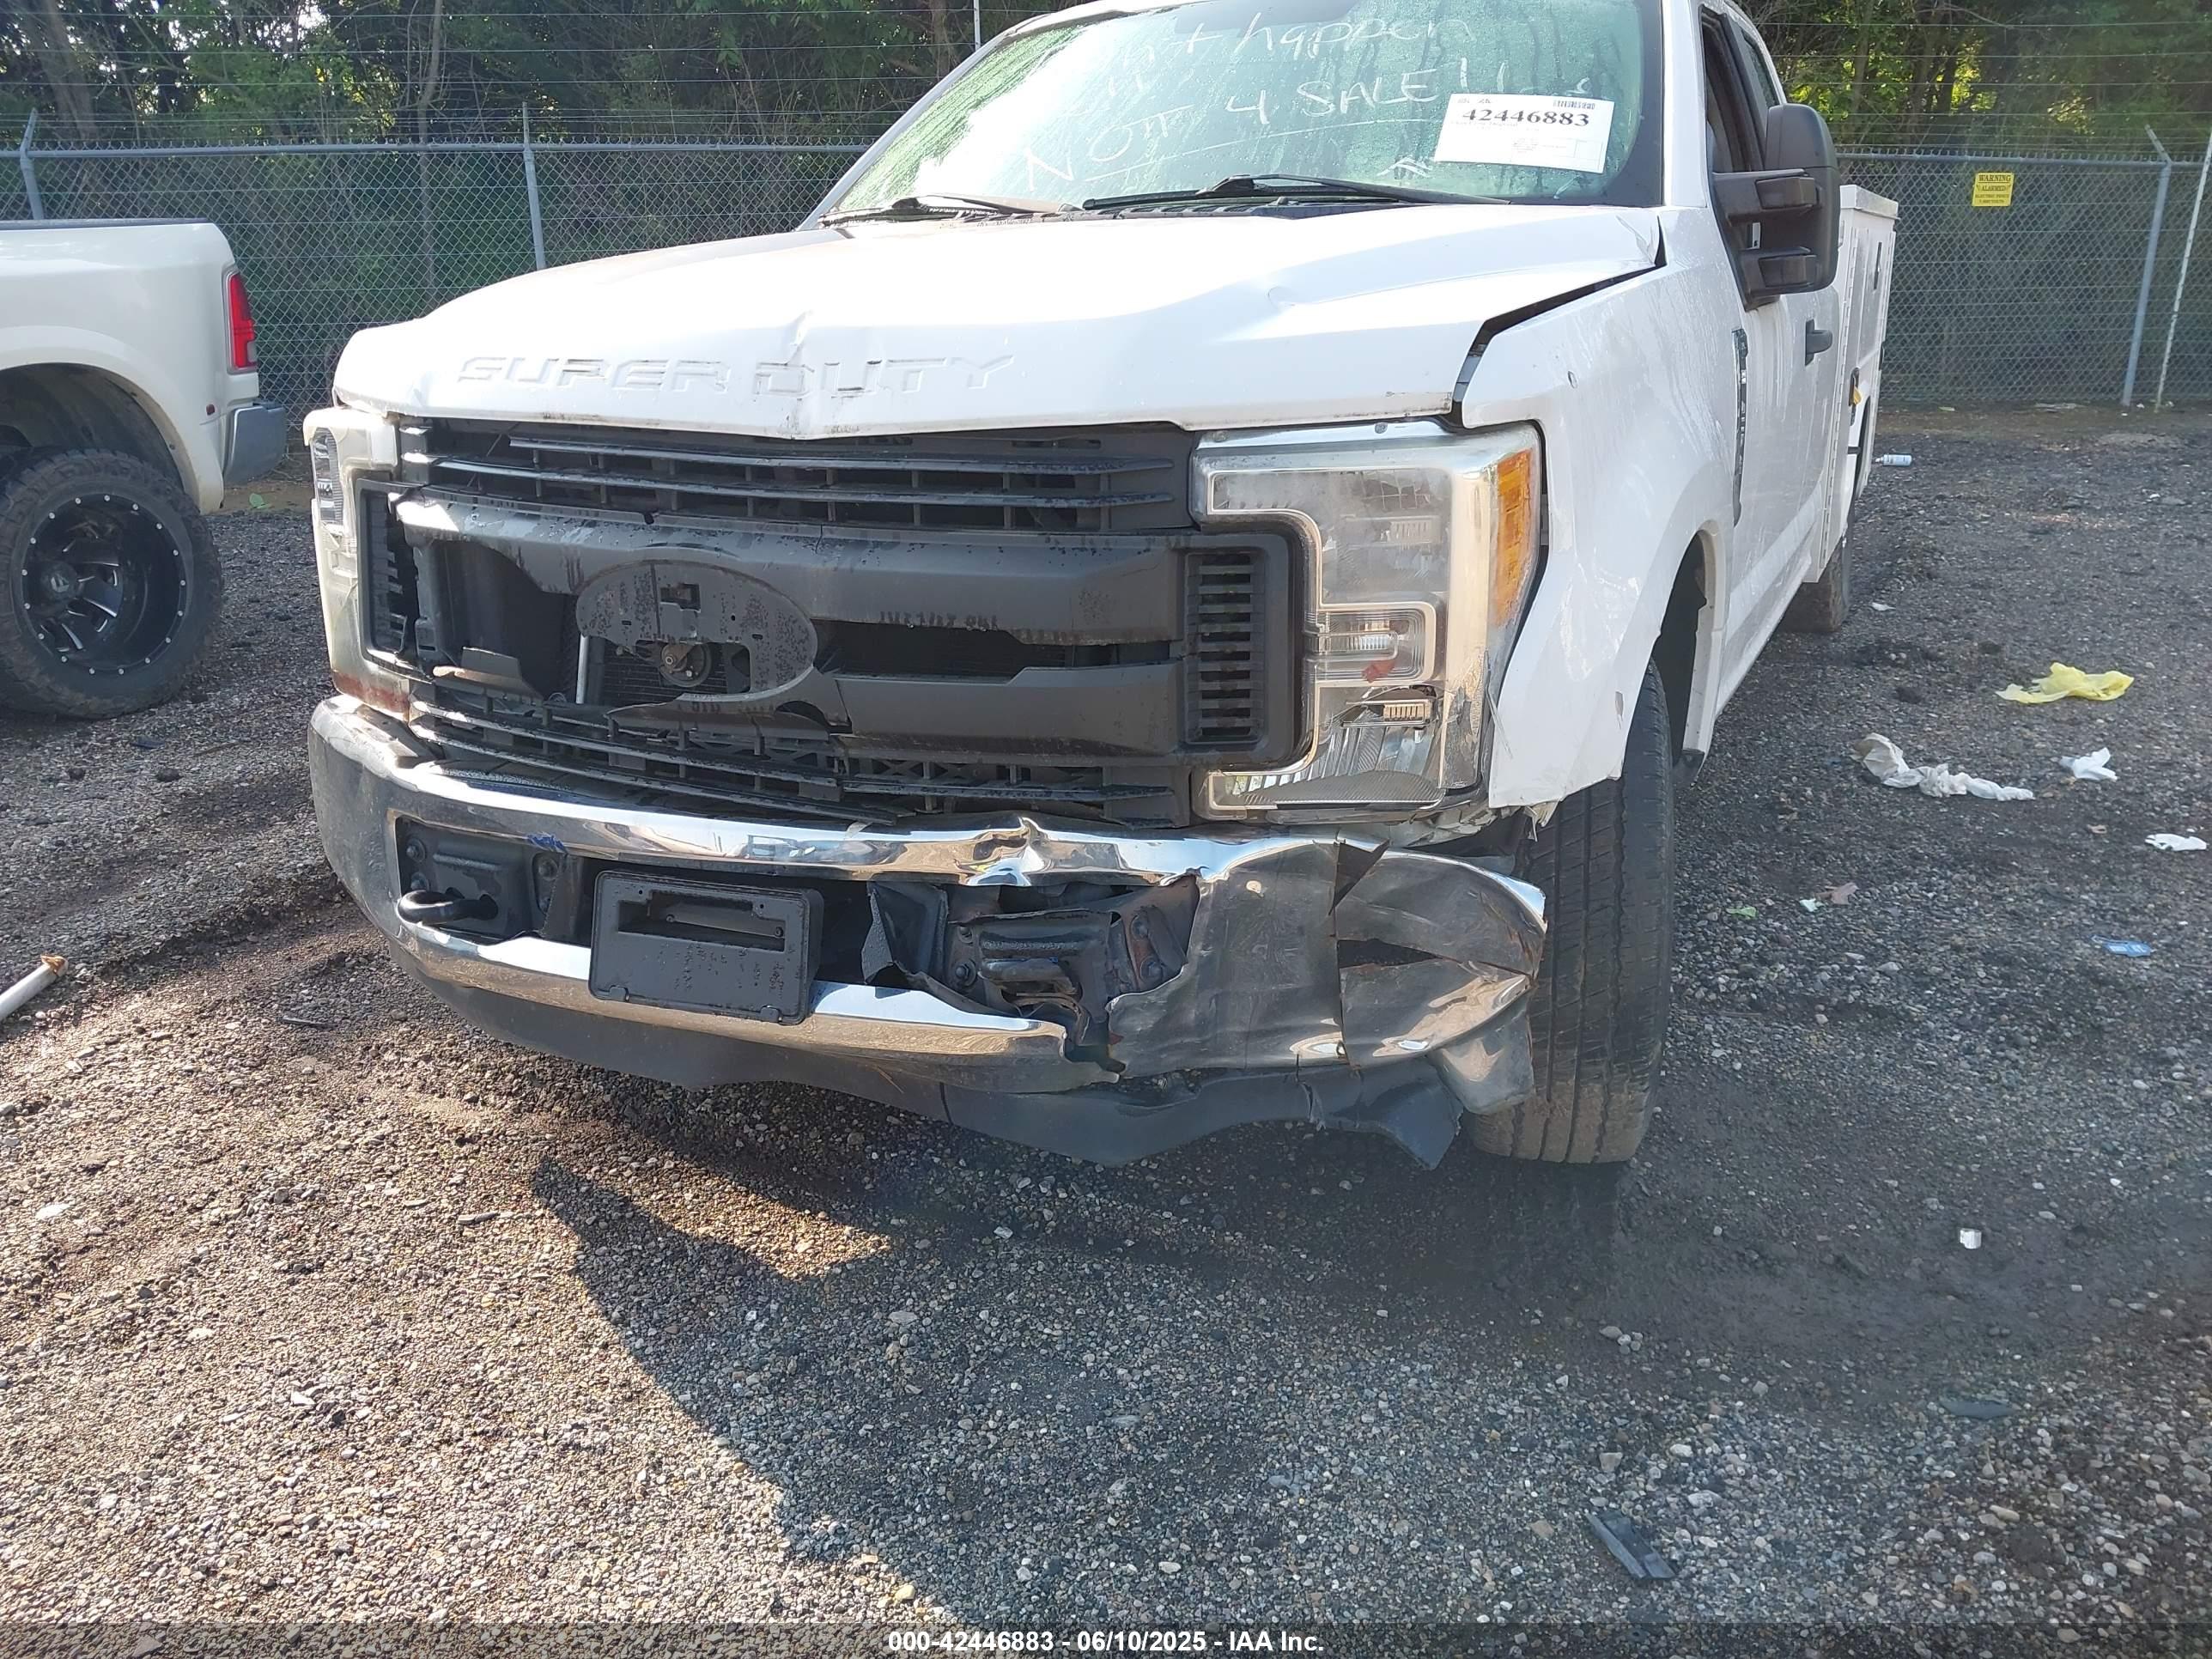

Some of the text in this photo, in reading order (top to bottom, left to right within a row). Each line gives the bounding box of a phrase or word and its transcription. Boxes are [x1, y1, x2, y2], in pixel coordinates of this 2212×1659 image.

[1024, 104, 1195, 191] NOT
[1225, 89, 1270, 125] 4
[1297, 69, 1440, 118] SALE
[1462, 108, 1589, 127] 42446883
[457, 353, 1016, 398] SUPER DUTY
